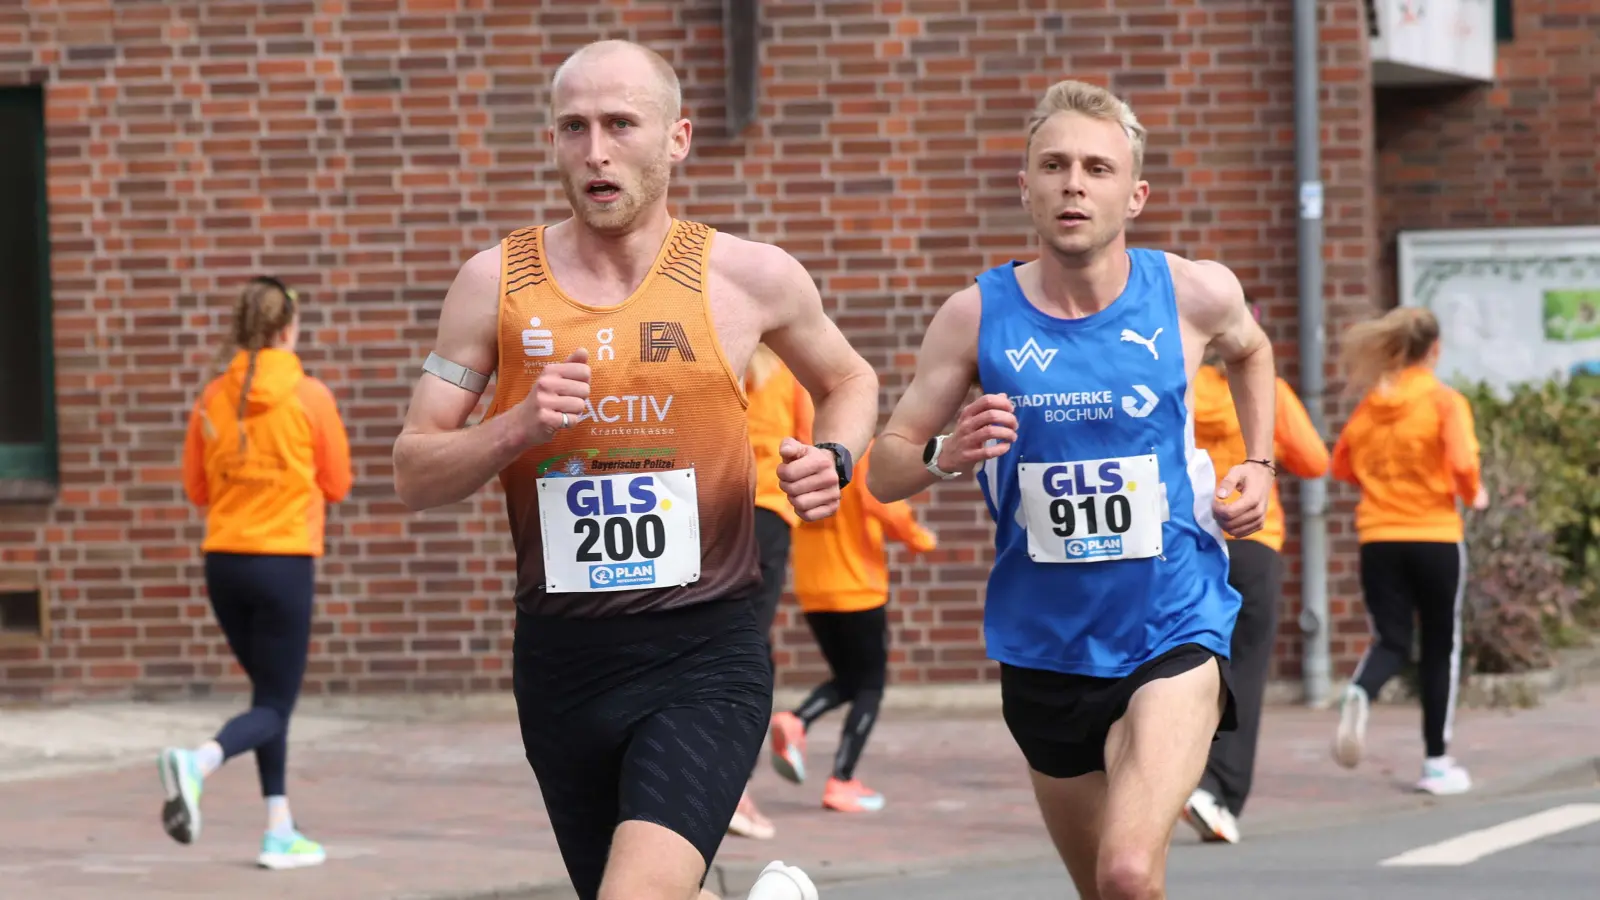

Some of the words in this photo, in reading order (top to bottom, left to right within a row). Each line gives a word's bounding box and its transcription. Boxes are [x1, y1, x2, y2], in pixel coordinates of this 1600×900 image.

[1009, 391, 1113, 409] STADTWERKE
[577, 395, 674, 423] ACTIV
[1044, 407, 1114, 422] BOCHUM
[590, 427, 675, 436] Krankenkasse
[591, 459, 641, 471] Bayerische
[643, 458, 676, 469] Polizei
[1050, 494, 1132, 537] 910
[574, 513, 666, 562] 200
[1087, 539, 1121, 551] PLAN
[615, 565, 653, 578] PLAN
